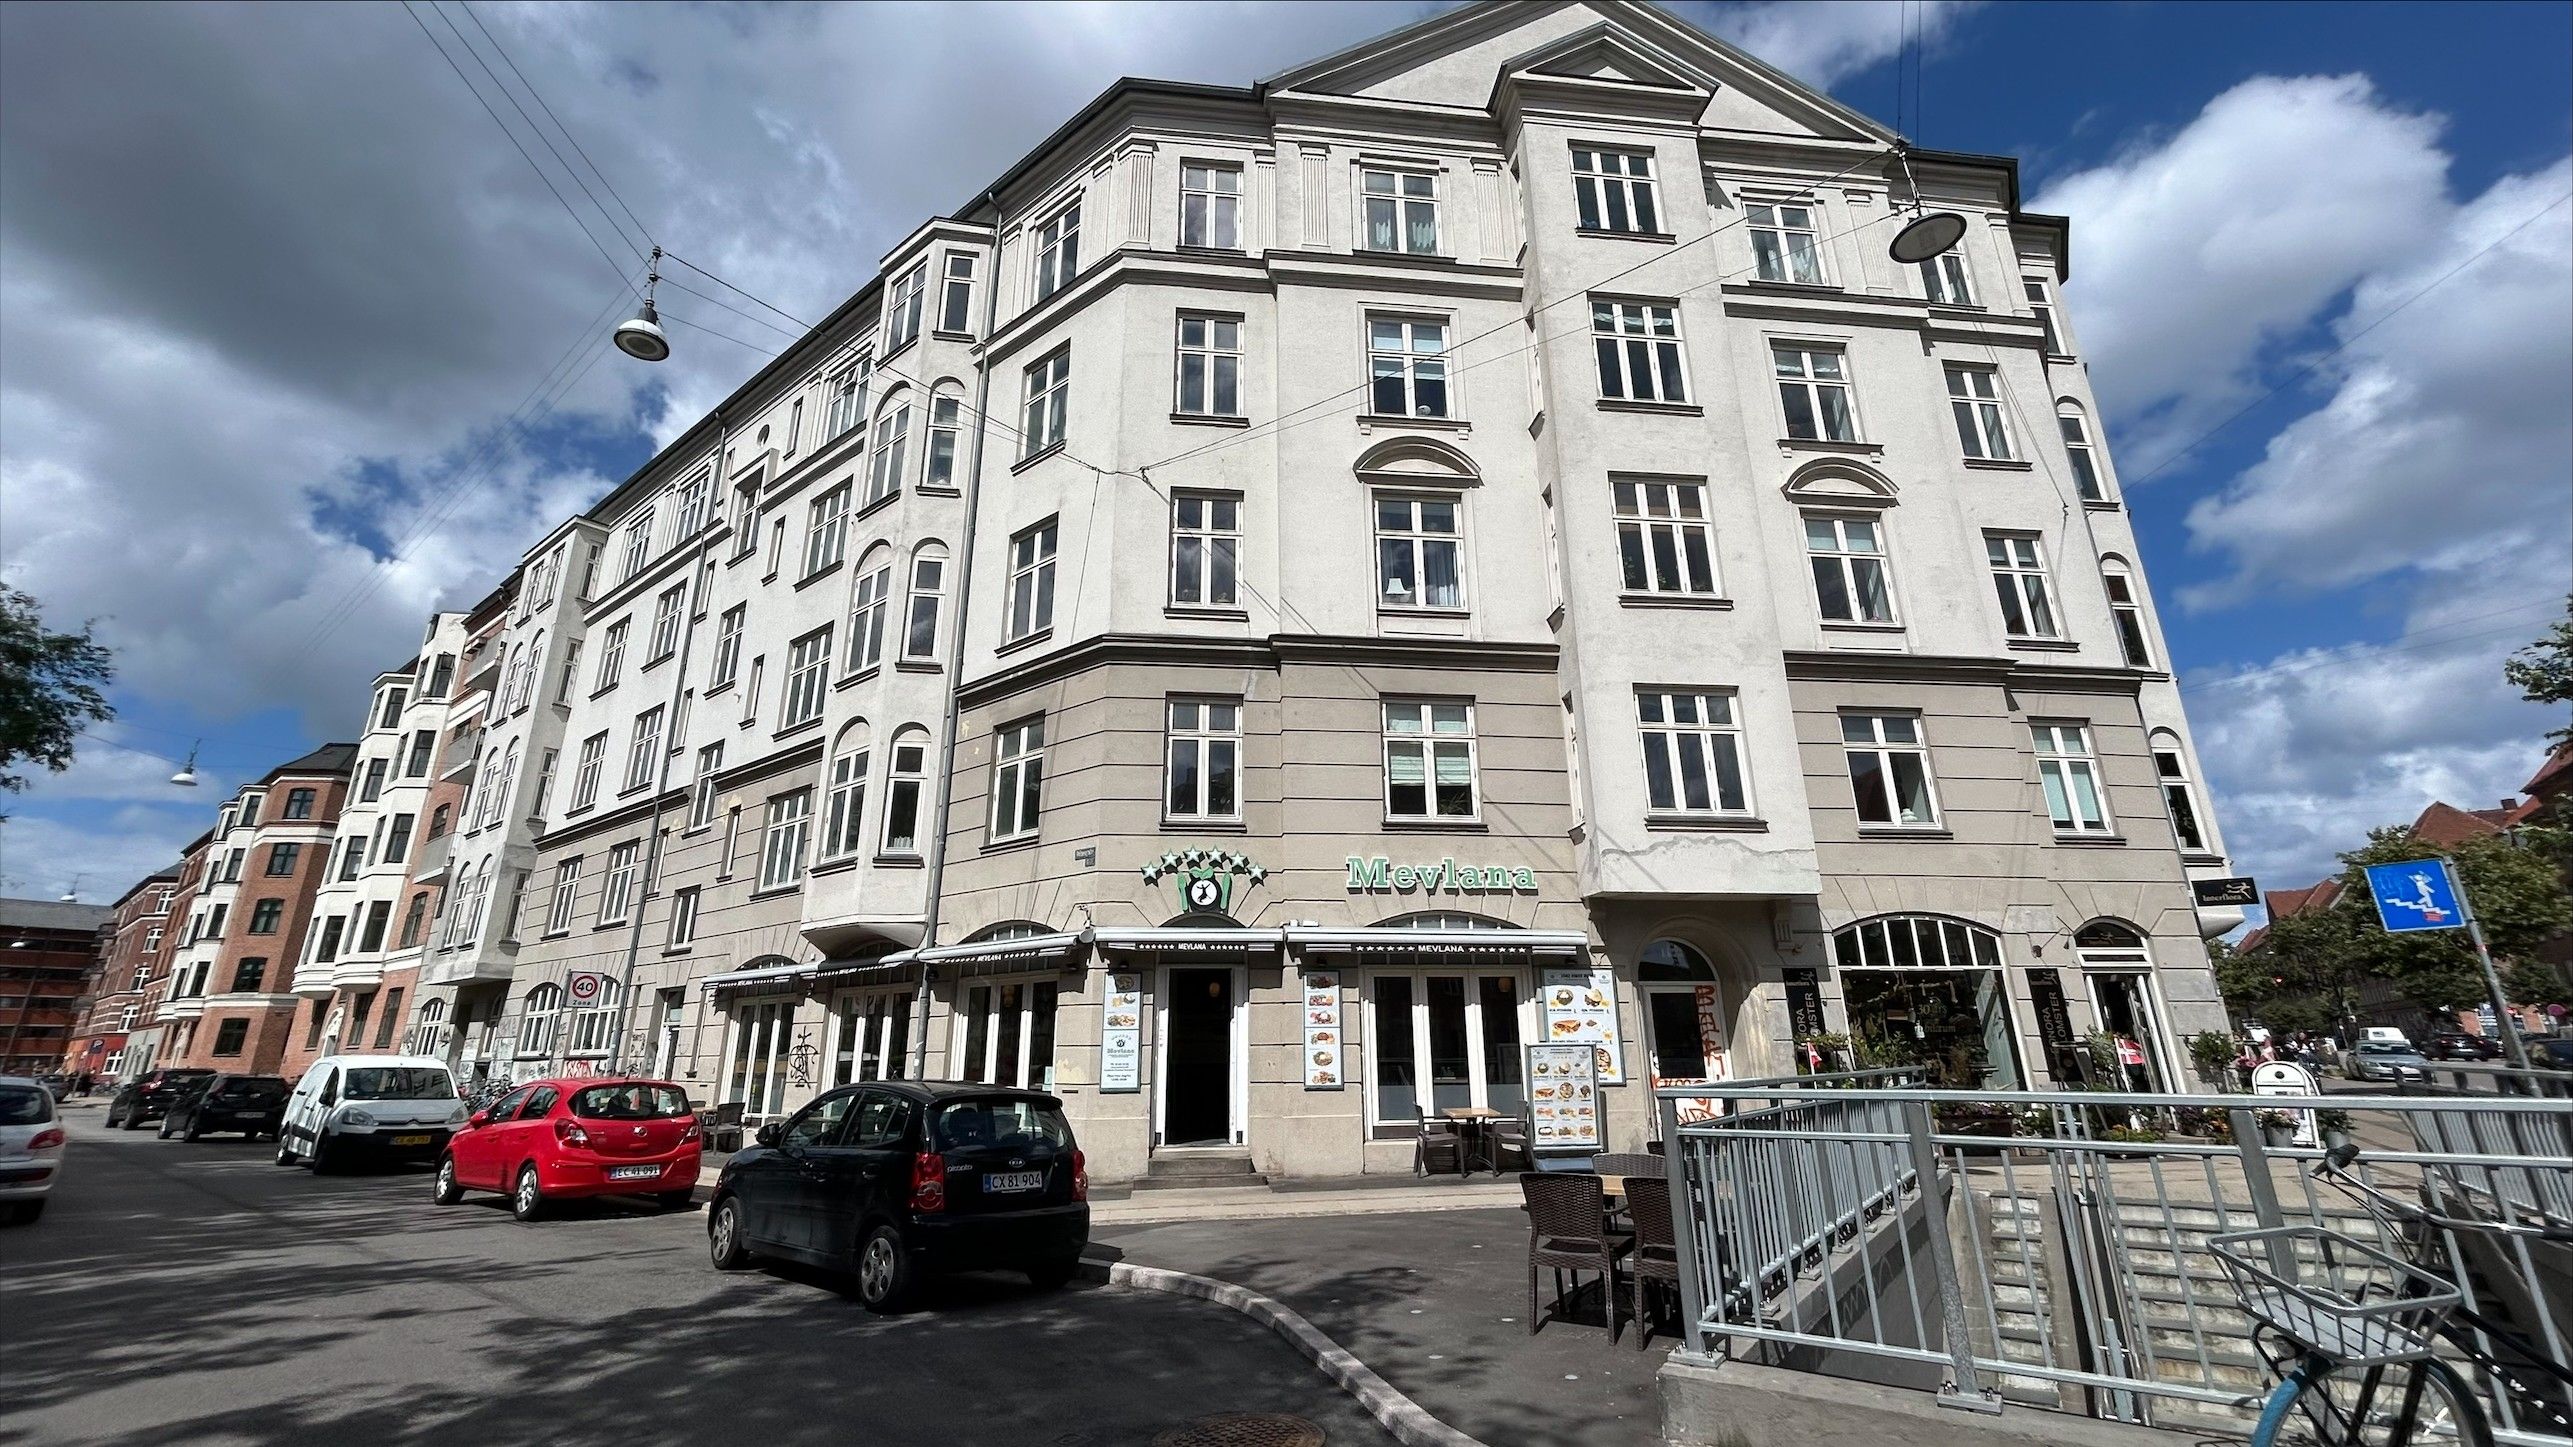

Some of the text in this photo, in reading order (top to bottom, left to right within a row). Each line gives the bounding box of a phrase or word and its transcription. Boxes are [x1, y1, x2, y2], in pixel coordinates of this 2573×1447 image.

[1346, 857, 1539, 894] Mevlana
[1178, 942, 1206, 950] MEVLANA
[1418, 944, 1465, 953] MEVLANA
[577, 982, 593, 991] 40
[992, 1173, 1041, 1189] CX 81 904
